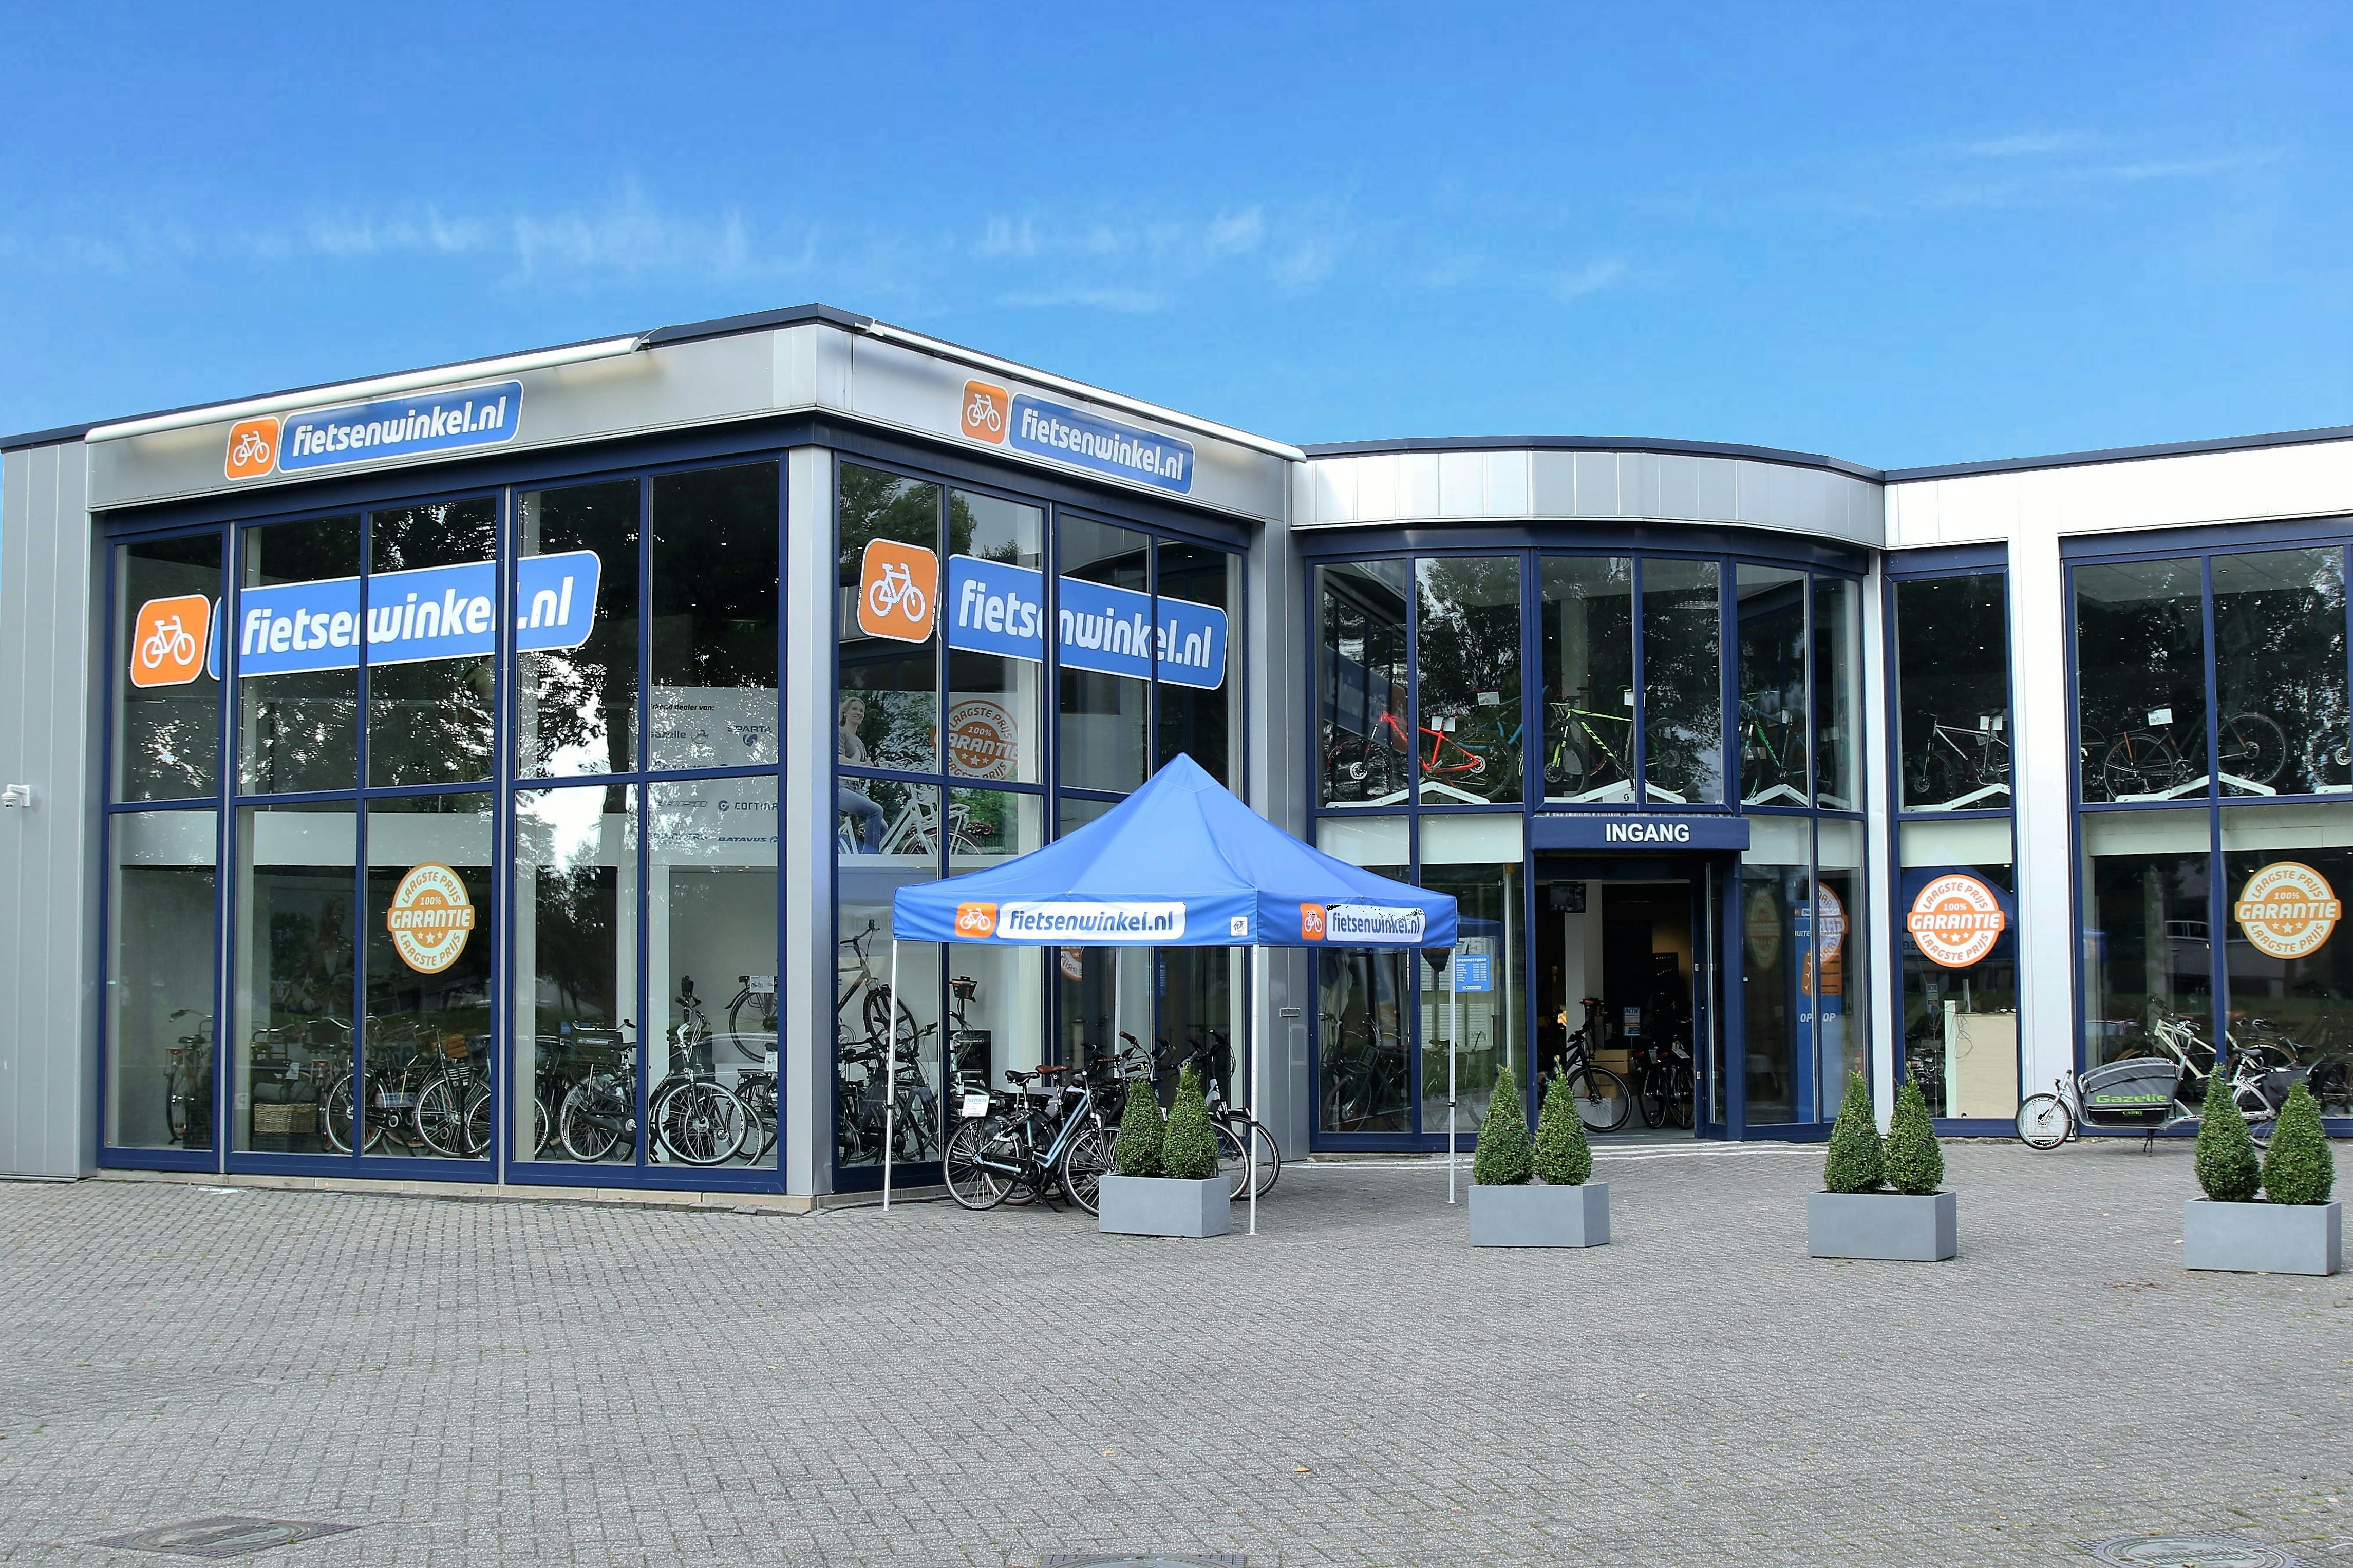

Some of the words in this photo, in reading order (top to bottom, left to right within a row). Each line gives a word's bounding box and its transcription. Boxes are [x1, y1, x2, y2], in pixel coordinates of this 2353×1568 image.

[292, 396, 507, 457] fietsenwinkel.nl
[1021, 408, 1184, 481] fietsenwinkel.nl
[241, 576, 574, 656] fietsewinke.nl
[949, 707, 992, 728] LAAGSTE
[992, 714, 1012, 739] PRIJS
[968, 726, 991, 737] 100%
[934, 733, 1018, 760] ARANTIE
[1580, 722, 1616, 759] SCOTT
[1606, 823, 1690, 842] INGANG
[402, 871, 439, 904] LAAGSTE
[440, 875, 461, 903] PRIJS
[1923, 882, 1963, 909] LAAGSTE
[1965, 885, 1988, 909] PRIJS
[2252, 870, 2296, 899] LAAGSTE
[2297, 873, 2323, 897] PRIJS
[420, 896, 442, 905] 100%
[1943, 903, 1967, 911] 100%
[2274, 892, 2300, 900] 100%
[391, 909, 472, 929] GARANTIE
[1009, 910, 1173, 931] fietsenwinkel.nl
[1911, 913, 2000, 930] GARANTIE
[2239, 902, 2337, 919] GARANTIE
[1332, 912, 1421, 934] fietsenwinkel.nl
[1458, 937, 1482, 954] 75
[1922, 934, 1963, 961] LAAGSTE
[1966, 933, 1988, 958] PRIJS
[2251, 924, 2296, 952] LAAGSTE
[2300, 923, 2324, 949] PRIJS
[400, 934, 437, 966] LAAGSTE
[439, 933, 461, 963] PRIJS
[1800, 1013, 1812, 1022] OP
[1823, 1012, 1836, 1022] OP
[2096, 1093, 2168, 1103] Gazelle
